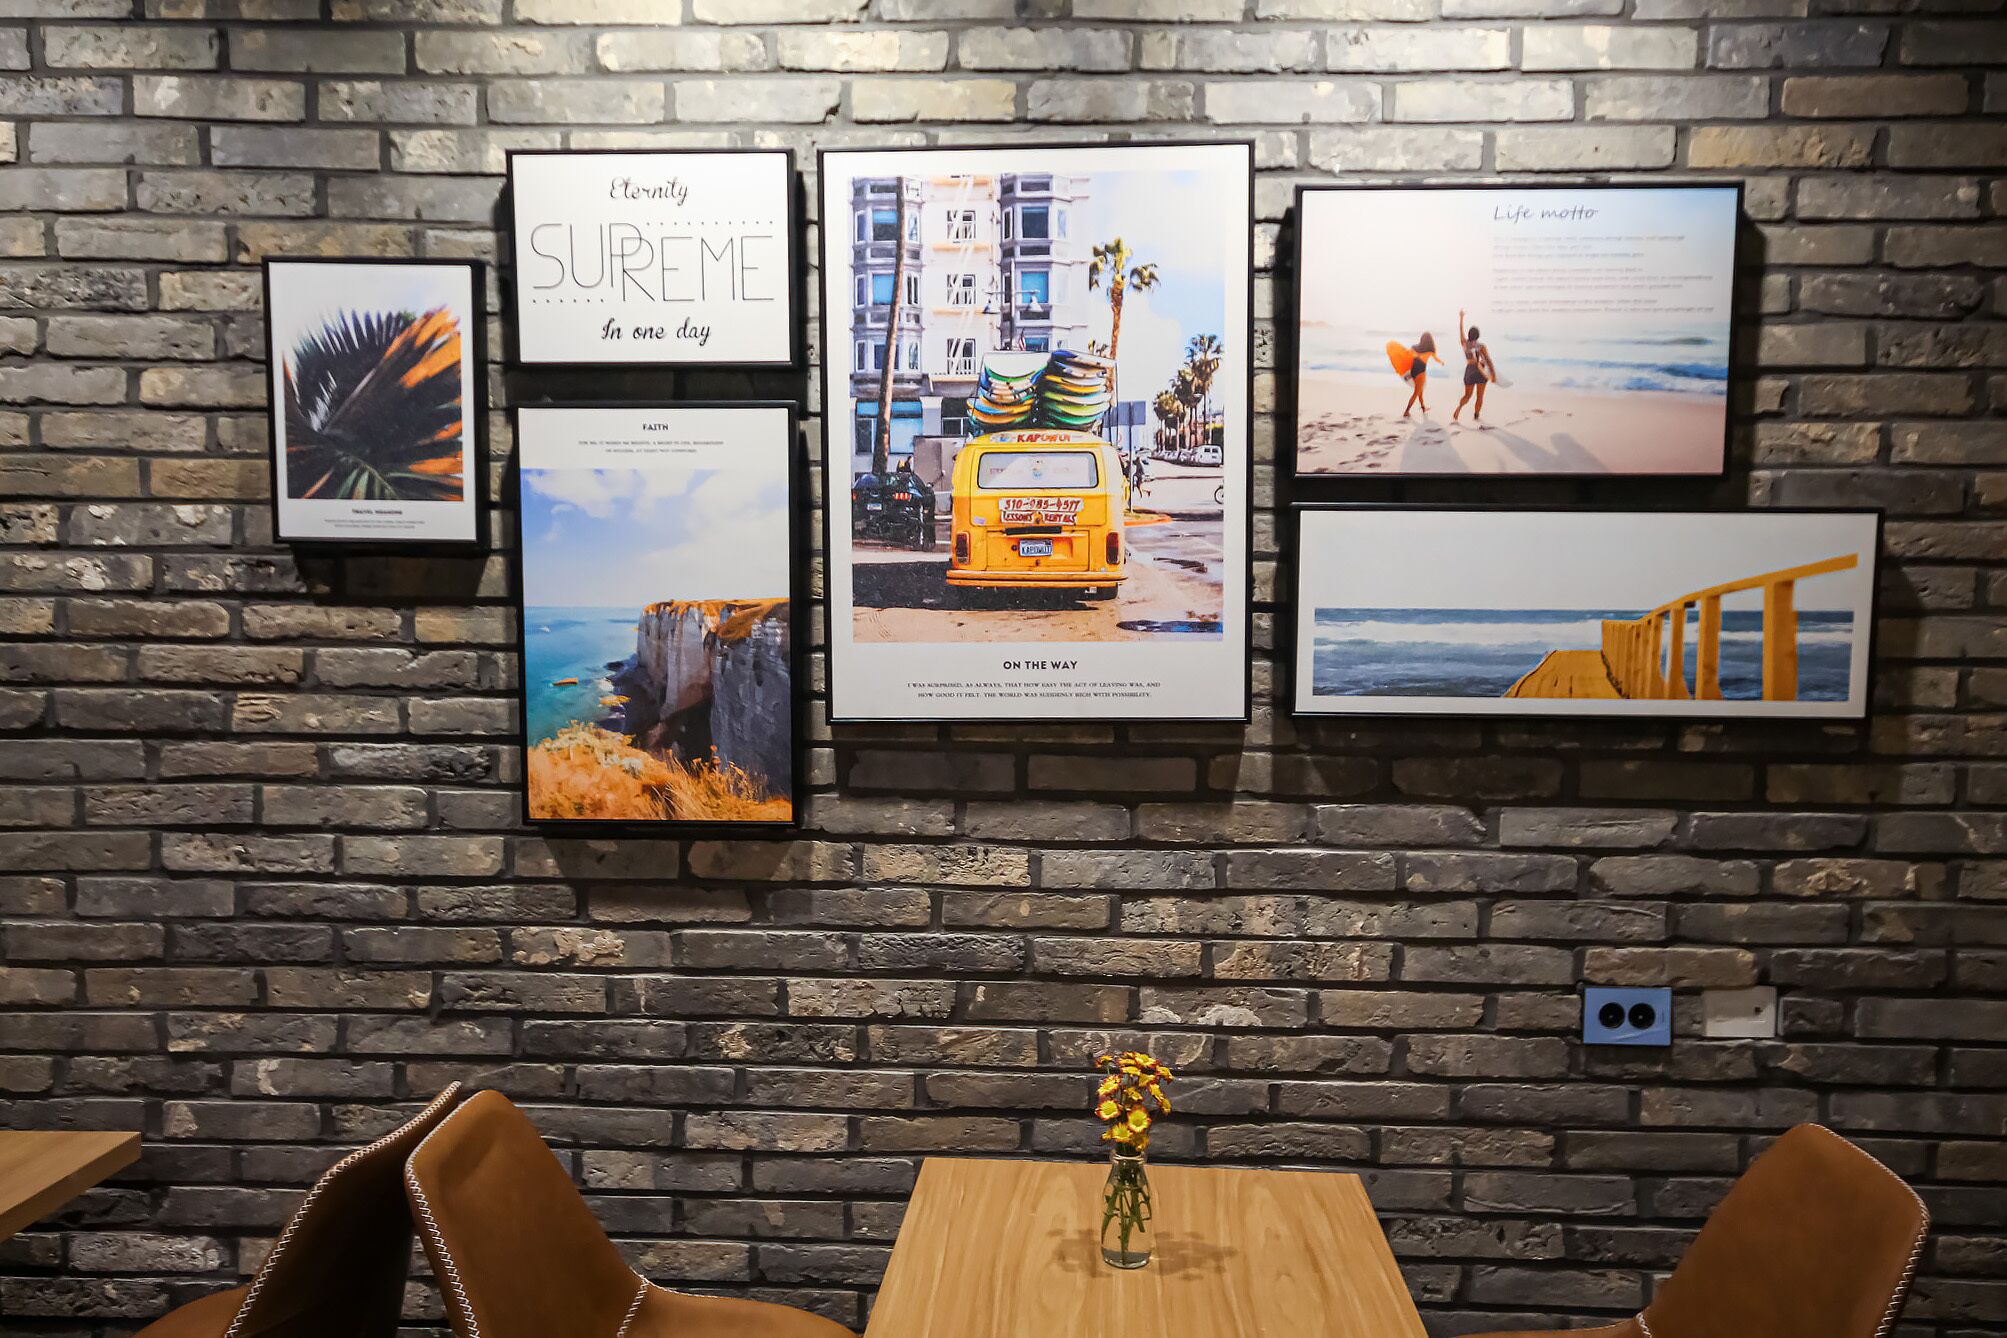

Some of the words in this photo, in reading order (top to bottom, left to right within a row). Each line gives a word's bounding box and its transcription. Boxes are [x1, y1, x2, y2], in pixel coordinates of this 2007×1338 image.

[609, 176, 688, 207] Eternity
[1493, 204, 1533, 224] Life
[1540, 204, 1599, 220] motto
[530, 221, 775, 302] SUPREME
[601, 317, 623, 340] In
[632, 325, 667, 340] one
[676, 315, 712, 347] day
[642, 423, 669, 432] FAITH
[1003, 511, 1034, 522] LESSONS
[1002, 660, 1022, 671] ON
[1025, 660, 1048, 671] THE
[1050, 660, 1078, 671] WAY
